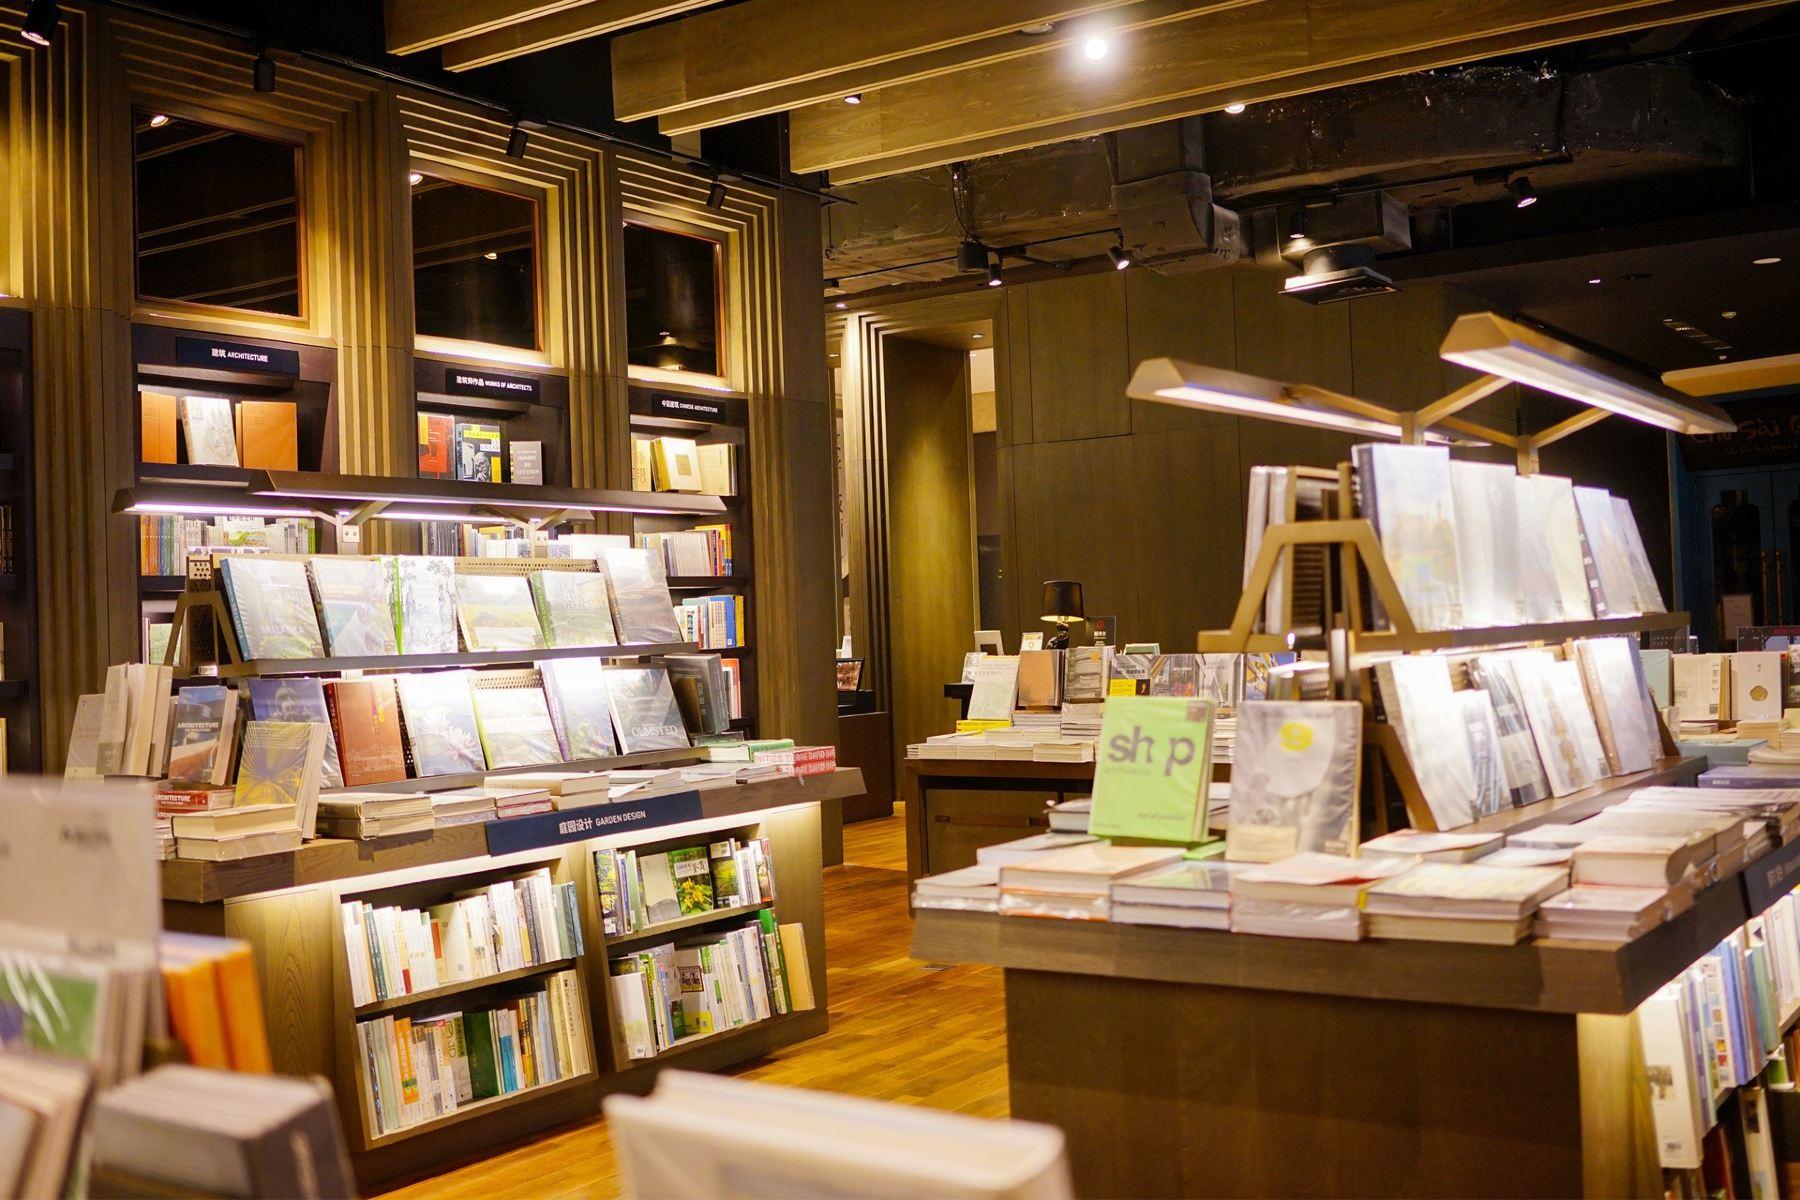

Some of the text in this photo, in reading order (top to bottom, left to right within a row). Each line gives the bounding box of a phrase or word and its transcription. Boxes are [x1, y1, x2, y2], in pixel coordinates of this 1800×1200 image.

[211, 347, 227, 359] 建筑
[227, 351, 269, 362] ARCHITECTURE
[485, 380, 500, 388] WORKS
[506, 382, 533, 392] ARCHITECTS
[694, 404, 718, 413] ARCHITECTURE
[177, 721, 219, 729] ARCHITECTURE
[631, 724, 678, 737] OLMSTED
[595, 810, 647, 827] GARDEN DESIGN
[558, 817, 593, 835] 庭园设计
